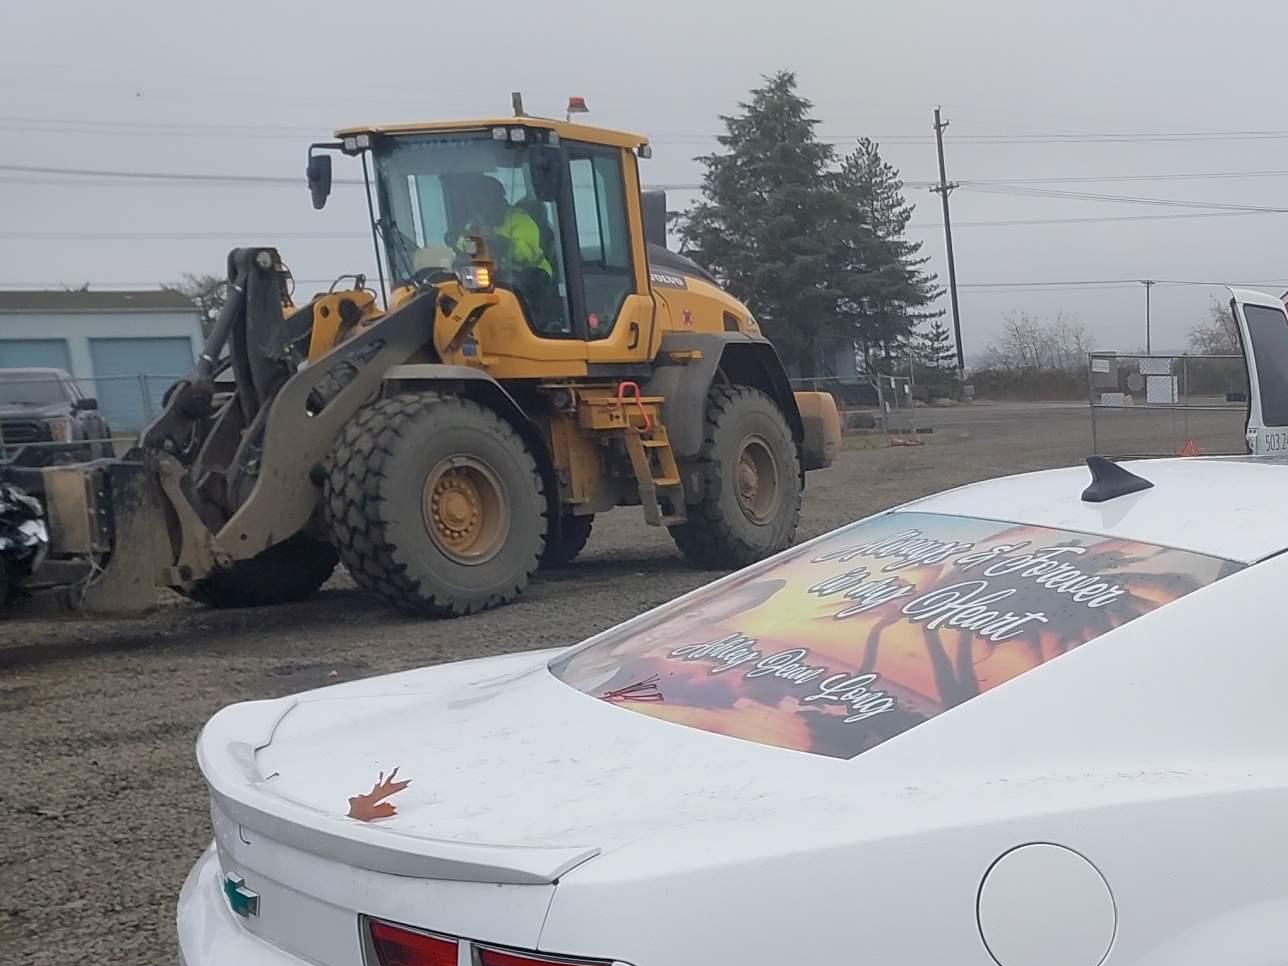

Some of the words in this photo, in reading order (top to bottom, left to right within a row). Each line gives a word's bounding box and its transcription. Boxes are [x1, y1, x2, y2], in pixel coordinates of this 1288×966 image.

[811, 529, 975, 572] Always
[956, 541, 1032, 571] &
[984, 547, 1126, 608] Forever
[836, 577, 917, 618] my
[902, 580, 1049, 641] Heart
[667, 633, 759, 673] Ashley
[746, 648, 825, 684] Jean
[803, 673, 895, 723] Long
